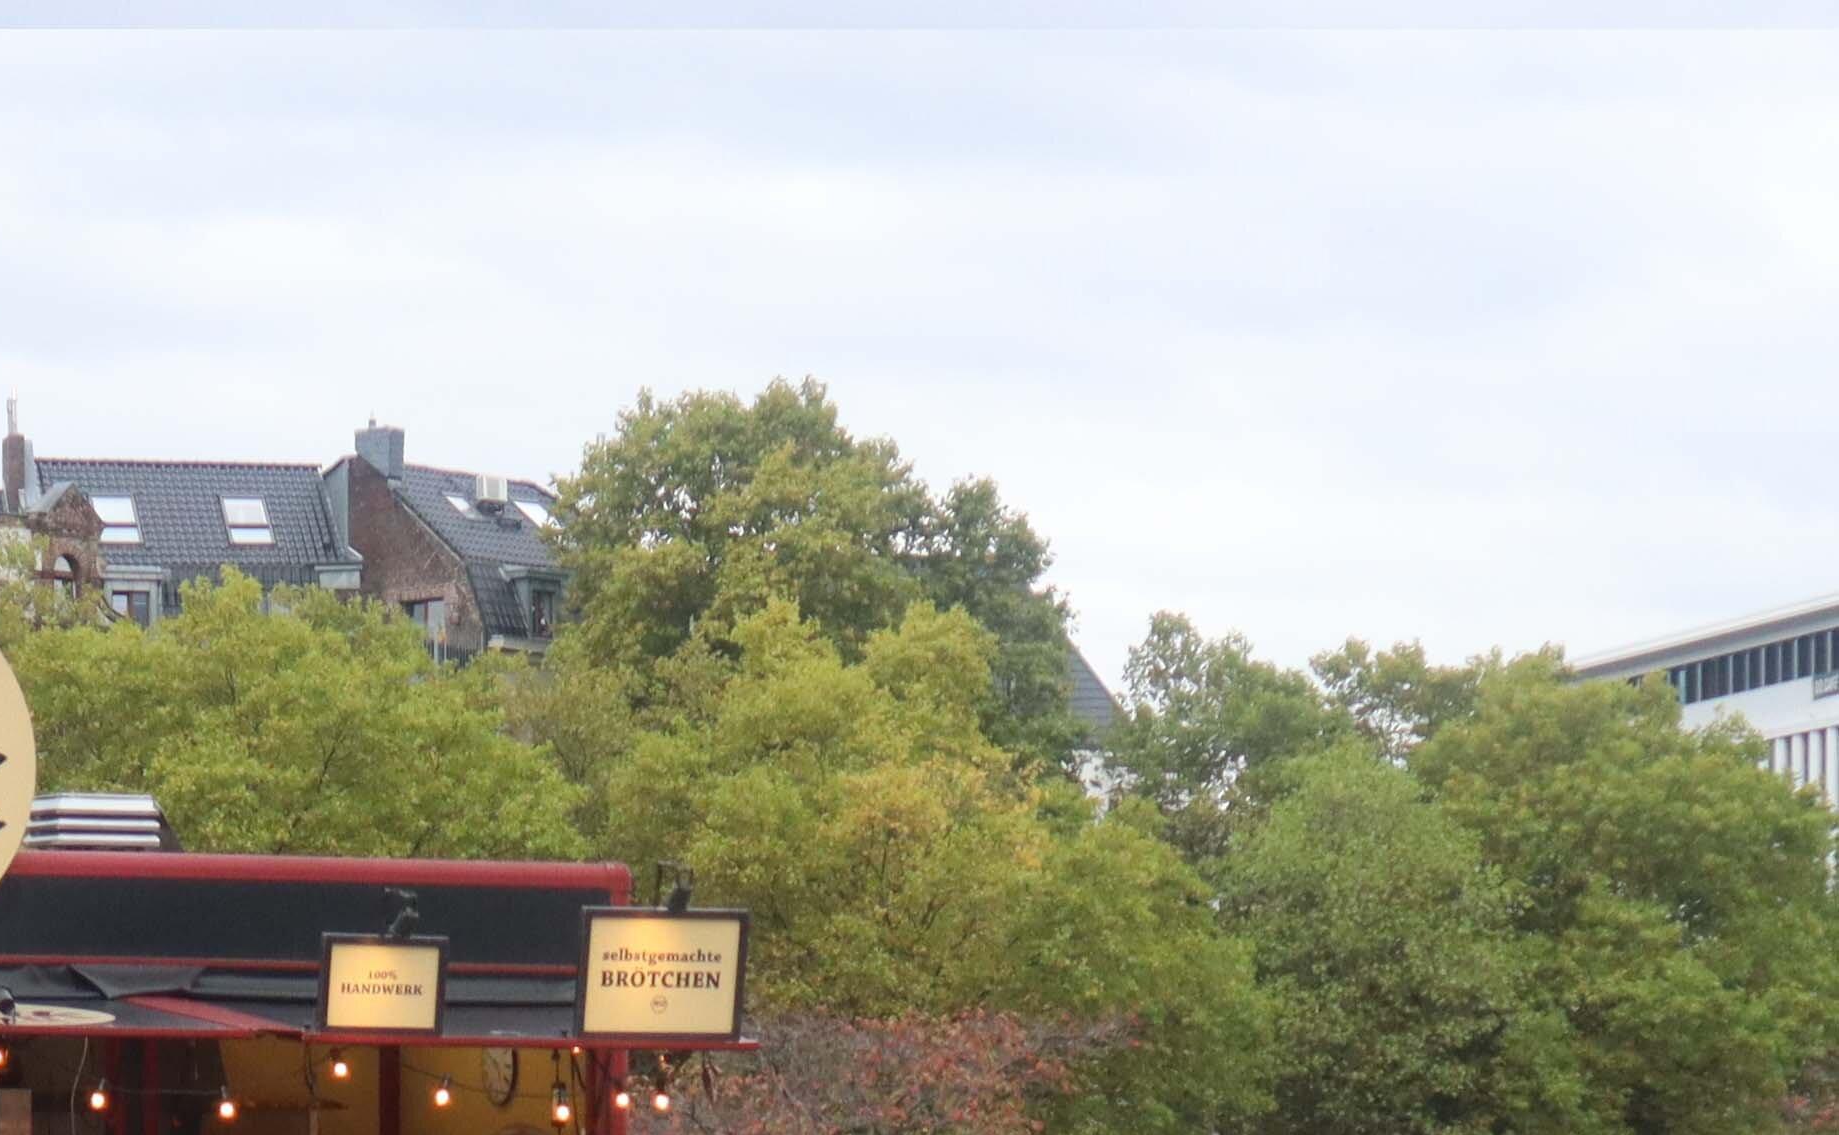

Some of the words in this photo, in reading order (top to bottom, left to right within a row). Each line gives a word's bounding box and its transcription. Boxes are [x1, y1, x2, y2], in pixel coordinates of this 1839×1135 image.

[602, 948, 722, 965] selbstgemachte
[369, 970, 398, 980] 100%
[601, 967, 721, 989] BRÖTCHEN
[341, 982, 423, 996] HANDWERK
